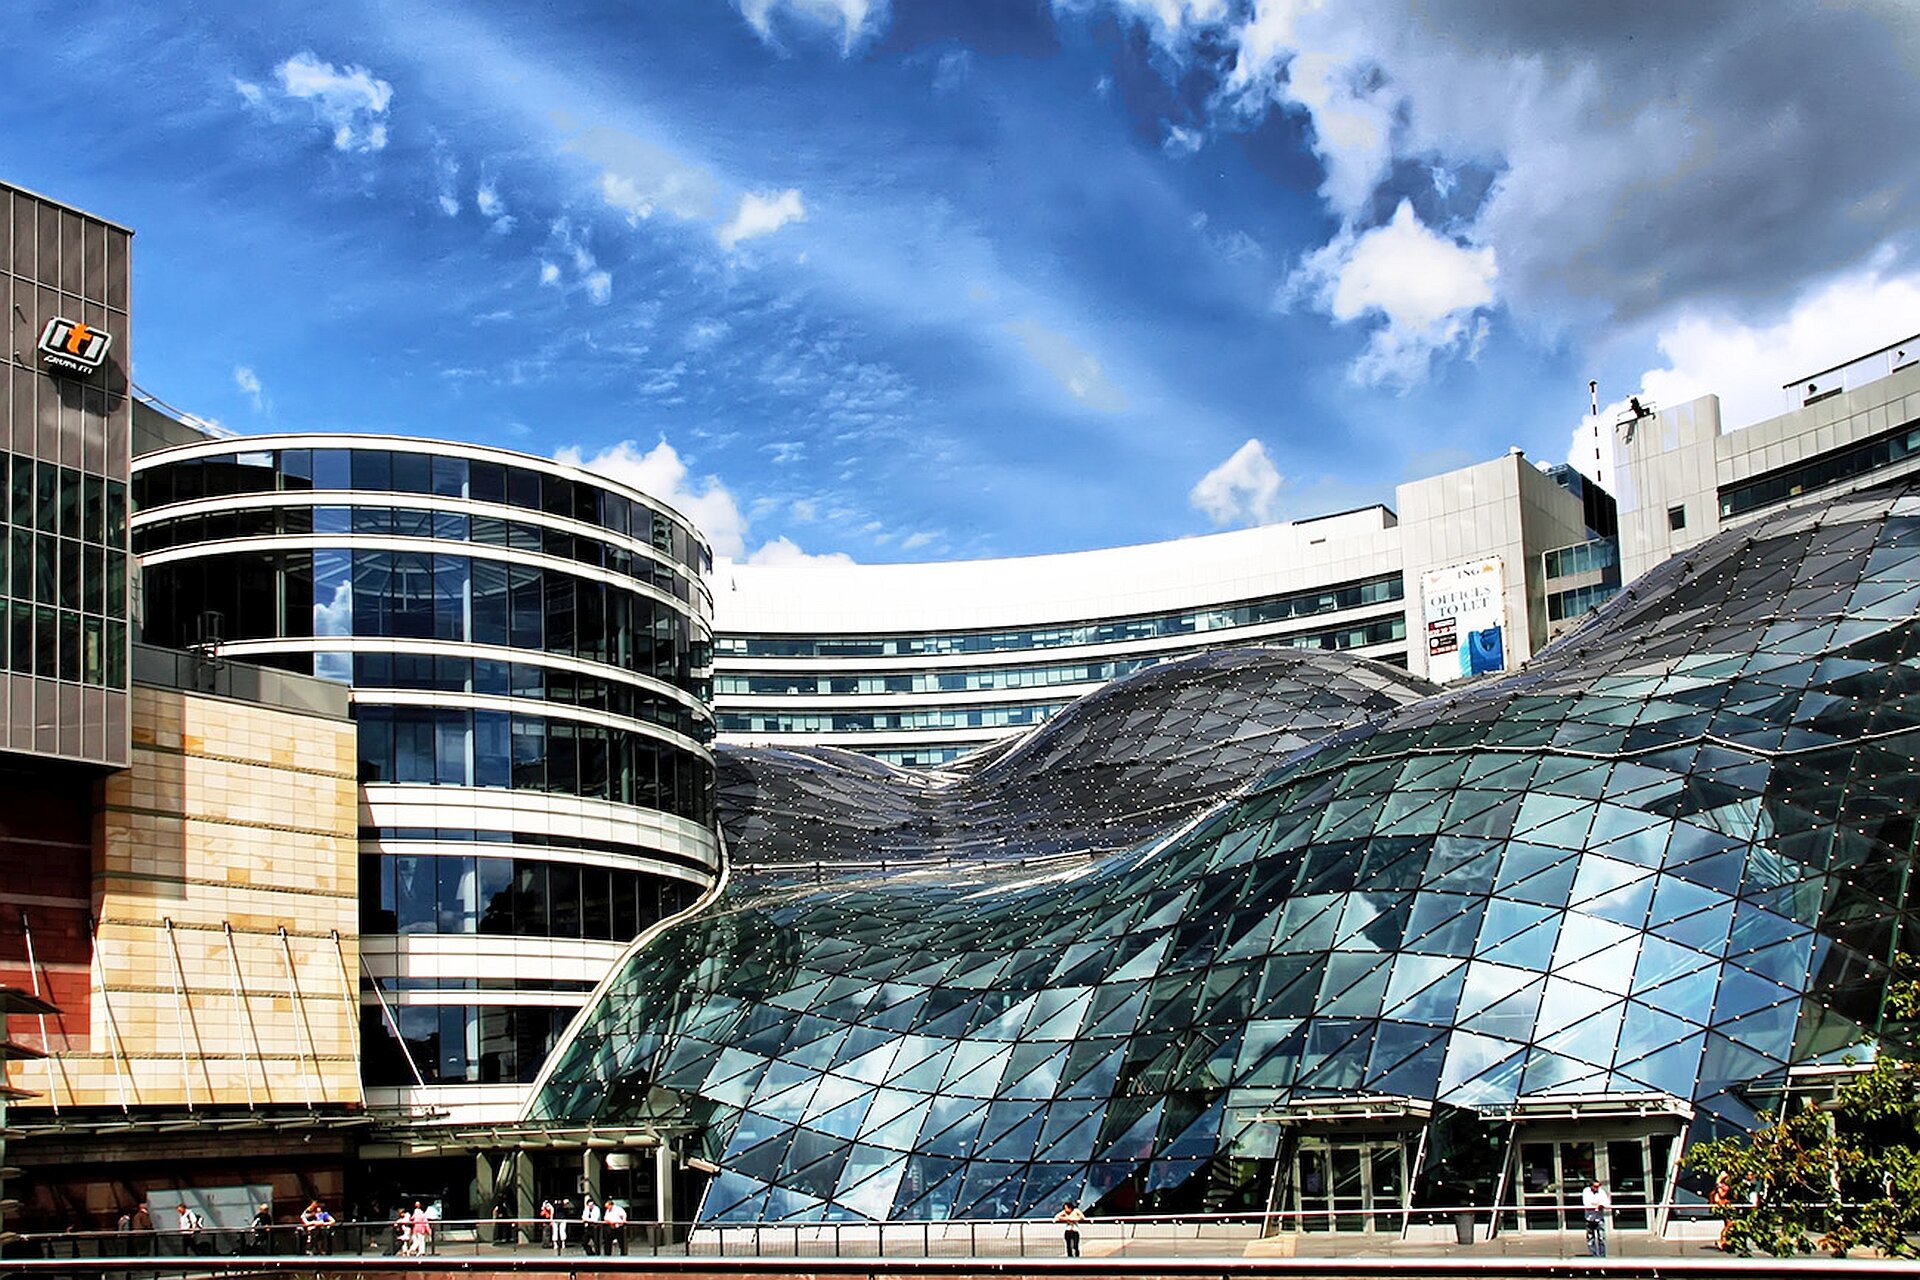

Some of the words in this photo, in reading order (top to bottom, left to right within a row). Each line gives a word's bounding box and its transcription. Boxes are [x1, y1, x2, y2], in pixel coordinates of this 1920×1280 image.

[1457, 569, 1480, 579] ING
[1430, 586, 1491, 606] OFFICES
[1437, 604, 1459, 617] TO
[1463, 596, 1489, 612] LET
